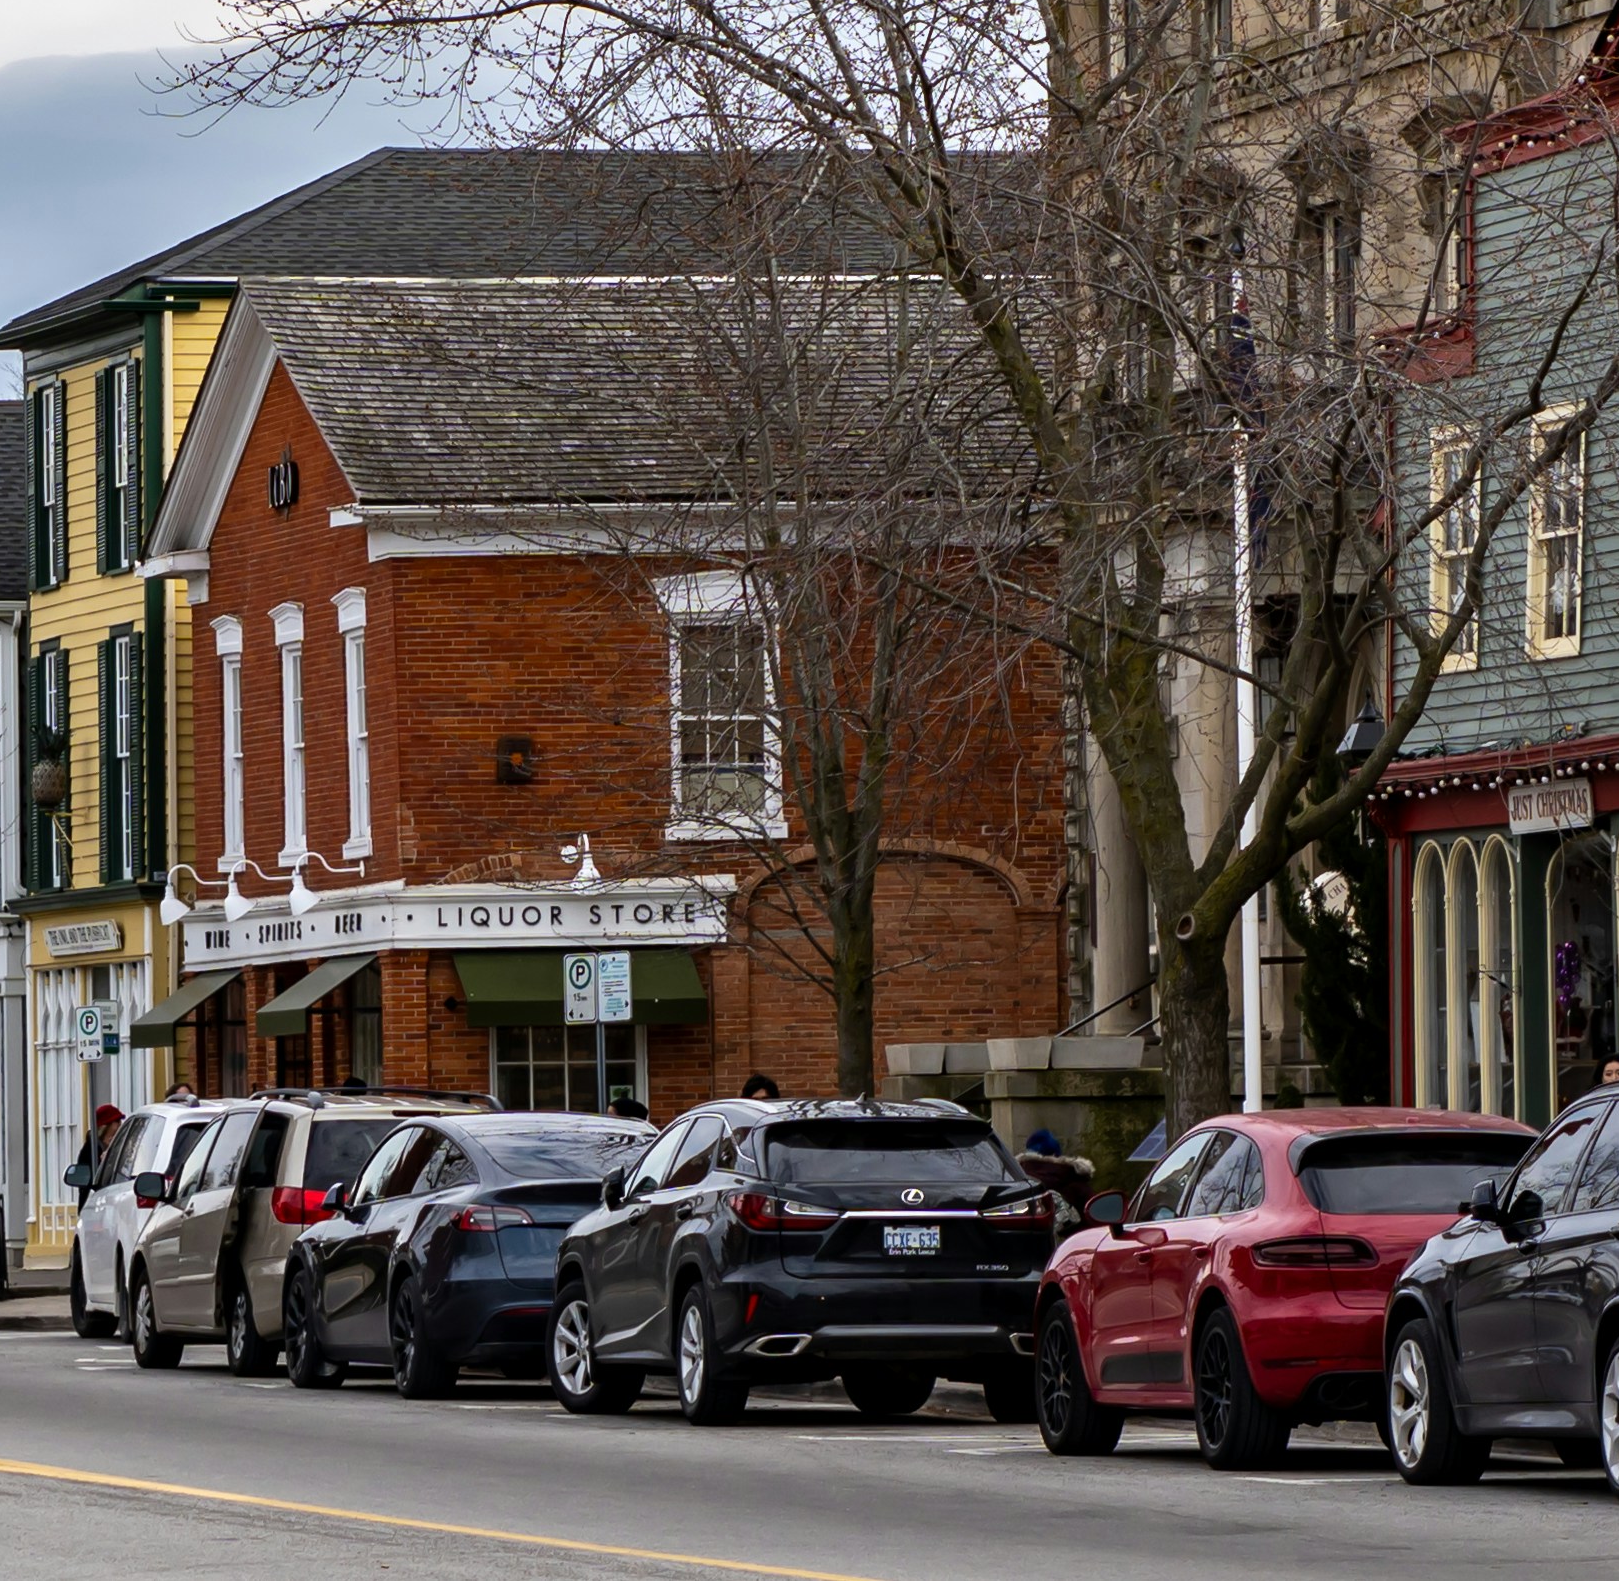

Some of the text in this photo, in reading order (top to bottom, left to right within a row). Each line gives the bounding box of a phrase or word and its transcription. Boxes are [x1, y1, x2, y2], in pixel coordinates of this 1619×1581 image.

[1511, 787, 1589, 821] JUST CHRISTMAS
[437, 903, 697, 928] LIQUOR STORE
[204, 912, 363, 950] WINE SPIRITS BEER
[575, 964, 586, 982] P
[85, 1015, 94, 1030] P
[918, 1232, 940, 1248] 635
